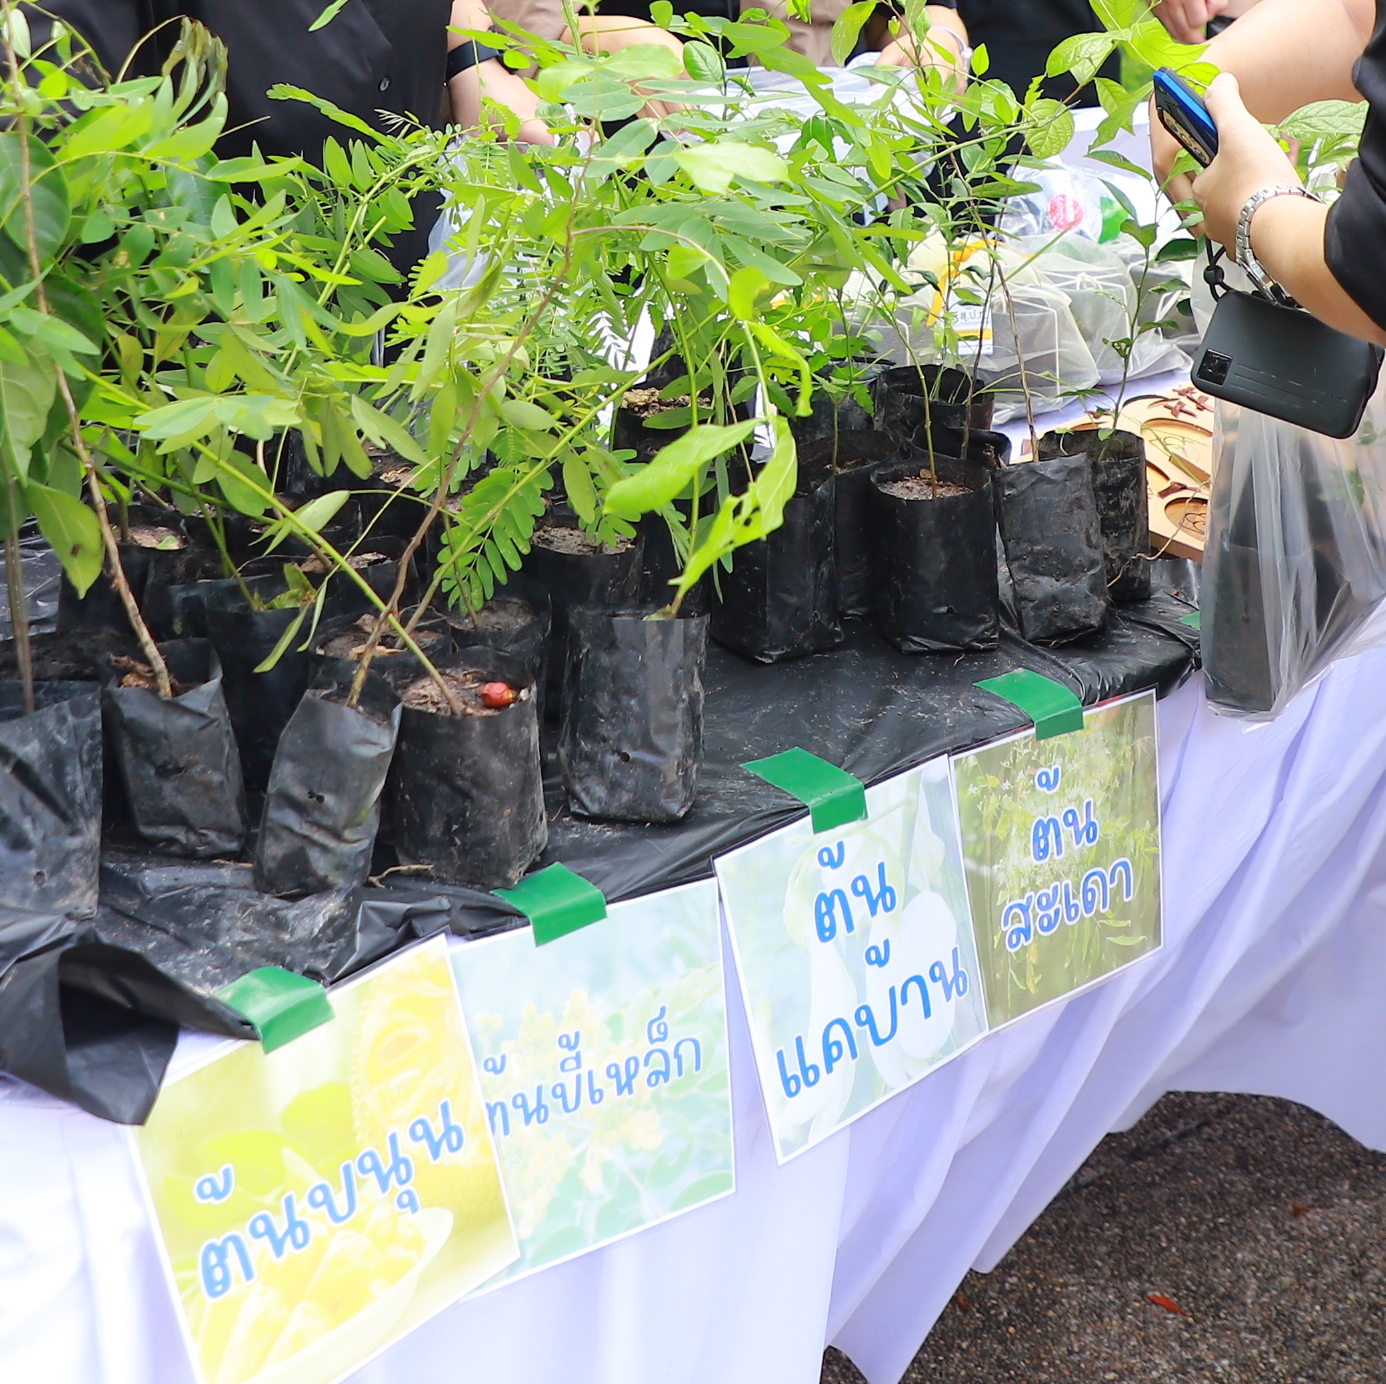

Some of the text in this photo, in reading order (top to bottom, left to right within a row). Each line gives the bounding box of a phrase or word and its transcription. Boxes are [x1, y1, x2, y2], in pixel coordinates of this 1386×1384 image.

[1033, 767, 1098, 862] ต้น
[814, 839, 897, 944] ต้น
[1002, 859, 1133, 950] สะเดา
[776, 937, 969, 1099] แคบ้าน
[195, 1099, 464, 1299] ต้นขนุน
